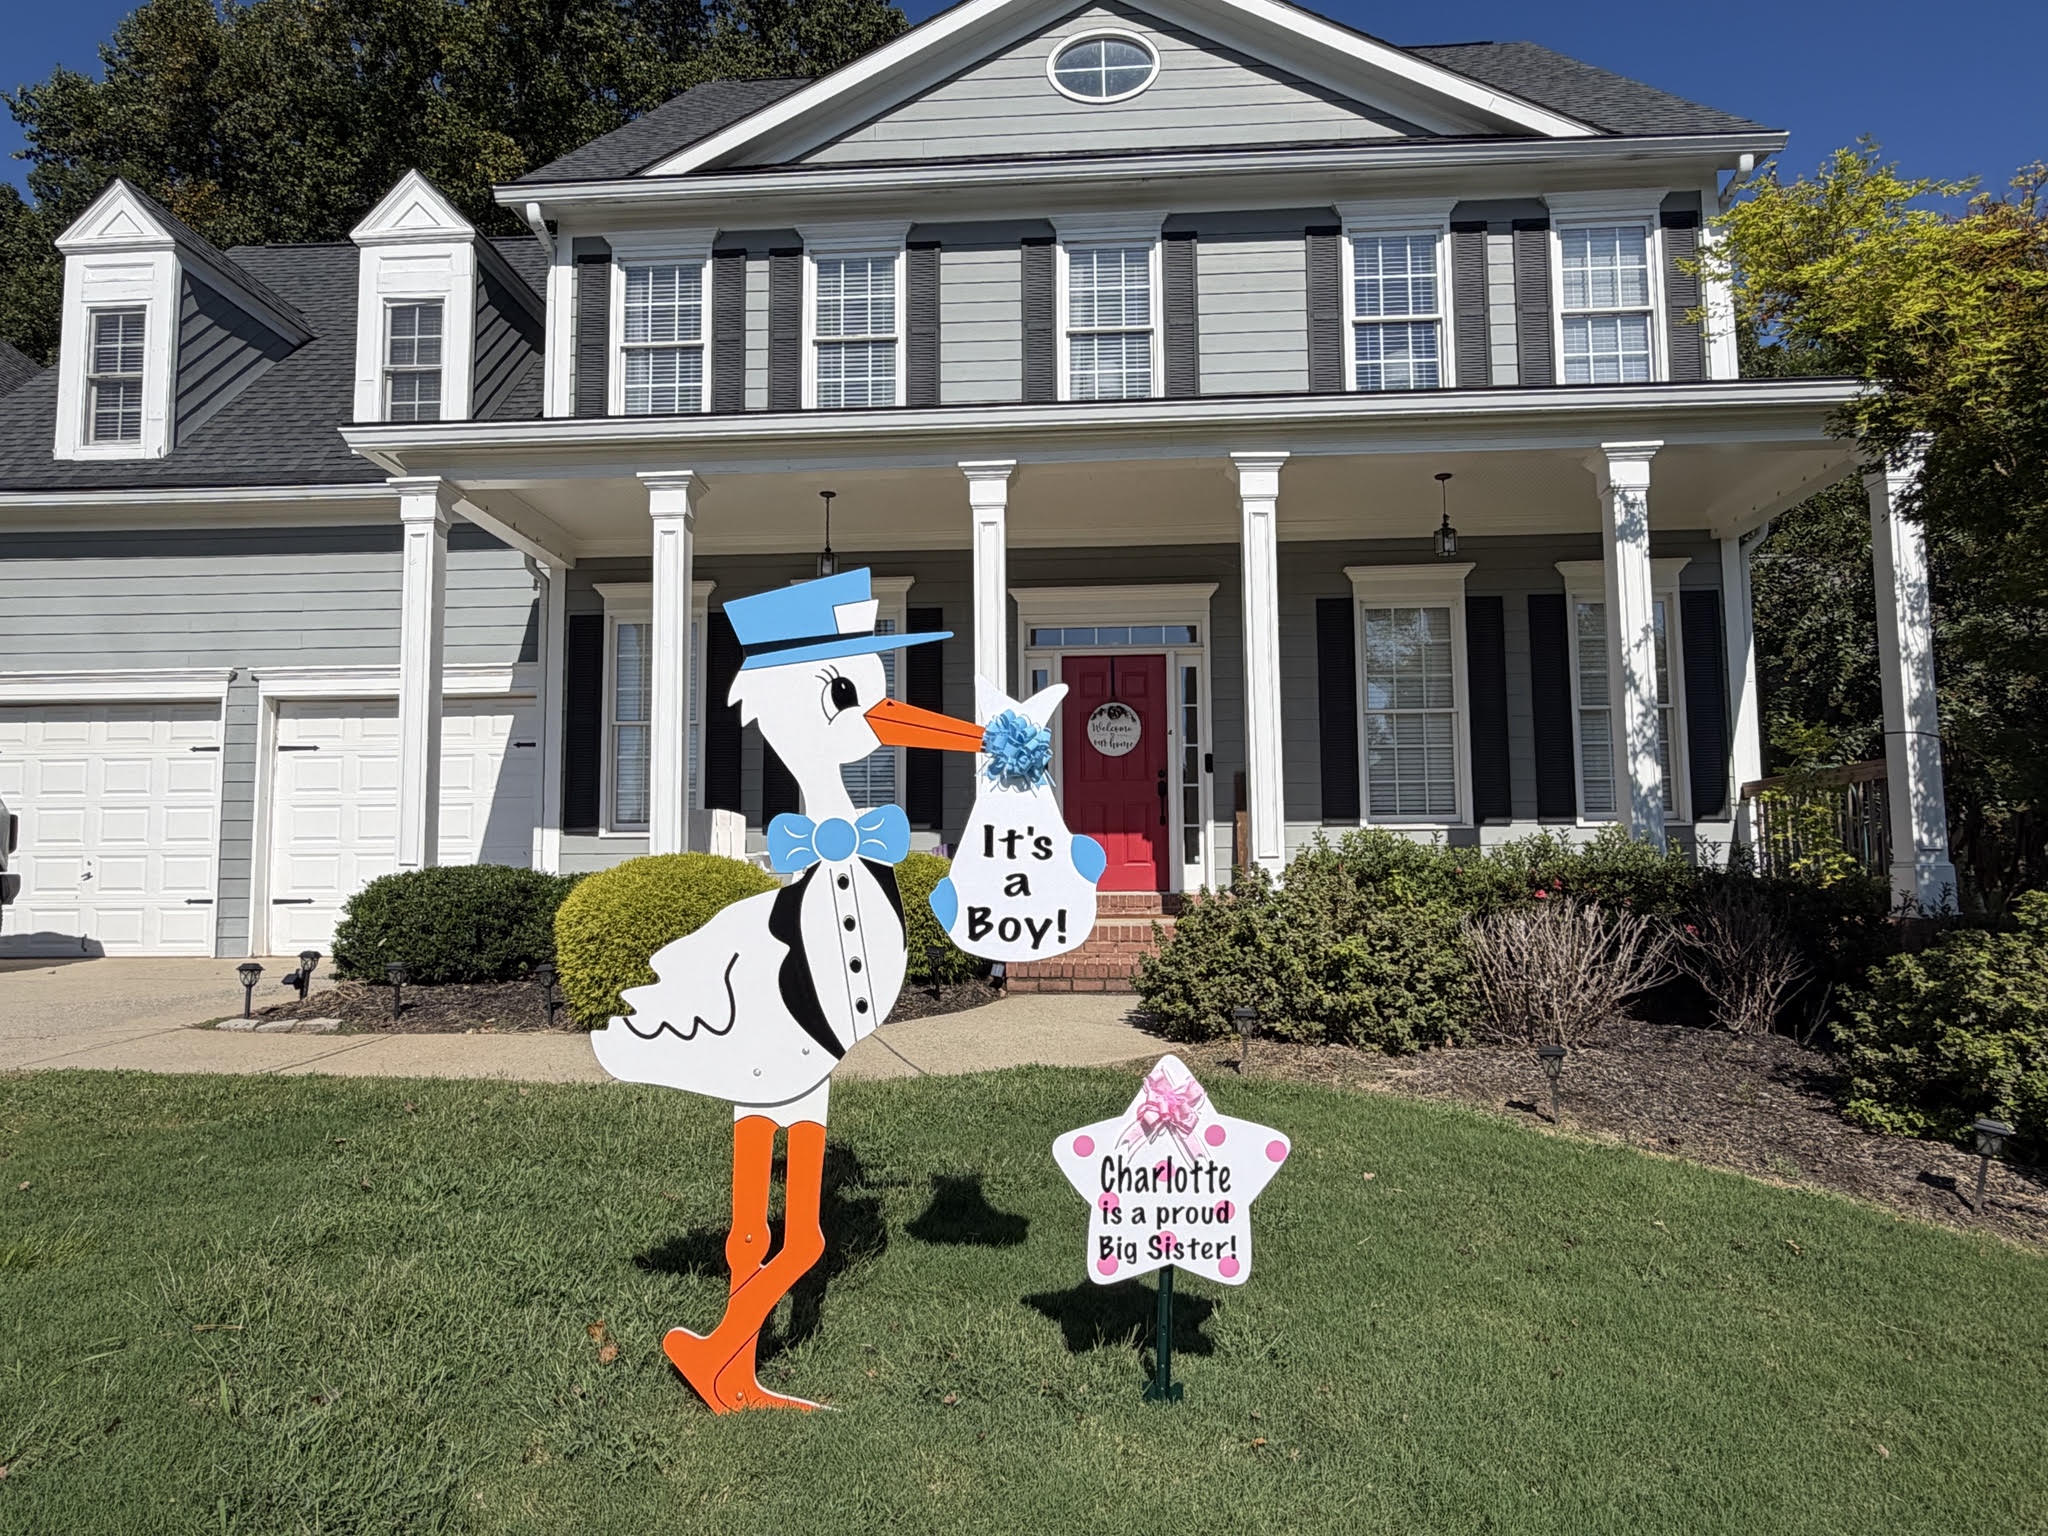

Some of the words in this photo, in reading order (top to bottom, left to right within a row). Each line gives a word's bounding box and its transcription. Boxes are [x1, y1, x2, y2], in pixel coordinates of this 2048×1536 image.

[1092, 721, 1132, 733] Welcome
[983, 824, 1053, 860] It's
[1004, 873, 1031, 897] a
[967, 906, 1067, 950] Boy!
[1101, 1155, 1231, 1194] Charlotte
[1102, 1200, 1122, 1225] is
[1131, 1206, 1146, 1225] a
[1156, 1200, 1230, 1229] proud
[1099, 1235, 1137, 1264] Big
[1147, 1235, 1237, 1260] Sister!
